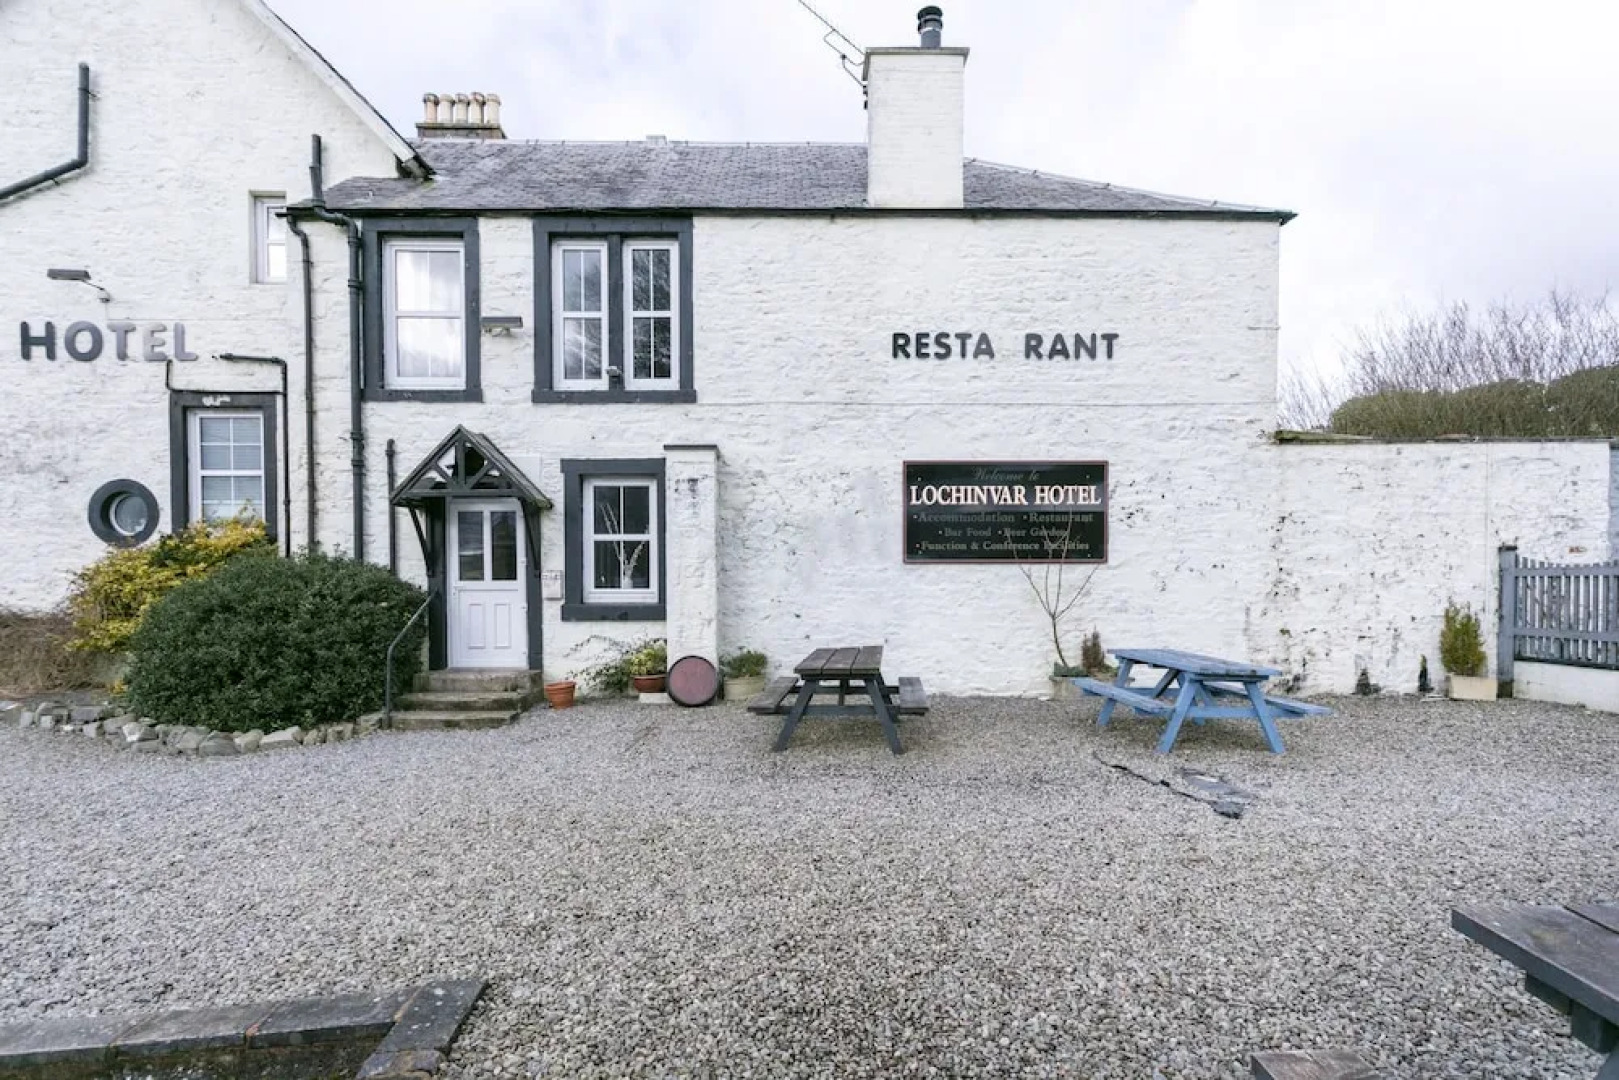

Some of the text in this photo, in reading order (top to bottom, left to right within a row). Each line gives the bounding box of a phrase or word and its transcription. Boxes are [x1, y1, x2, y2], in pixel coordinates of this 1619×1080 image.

[20, 320, 199, 362] HOTEL
[909, 485, 1102, 506] LOCHINVAR HOTEL
[917, 512, 1094, 523] Accommodation Restaurant
[944, 528, 963, 537] Bar
[966, 528, 992, 537] Food
[1004, 528, 1027, 537] Beer
[921, 541, 968, 551] Function
[971, 541, 979, 551] &
[983, 541, 1040, 551] Conference
